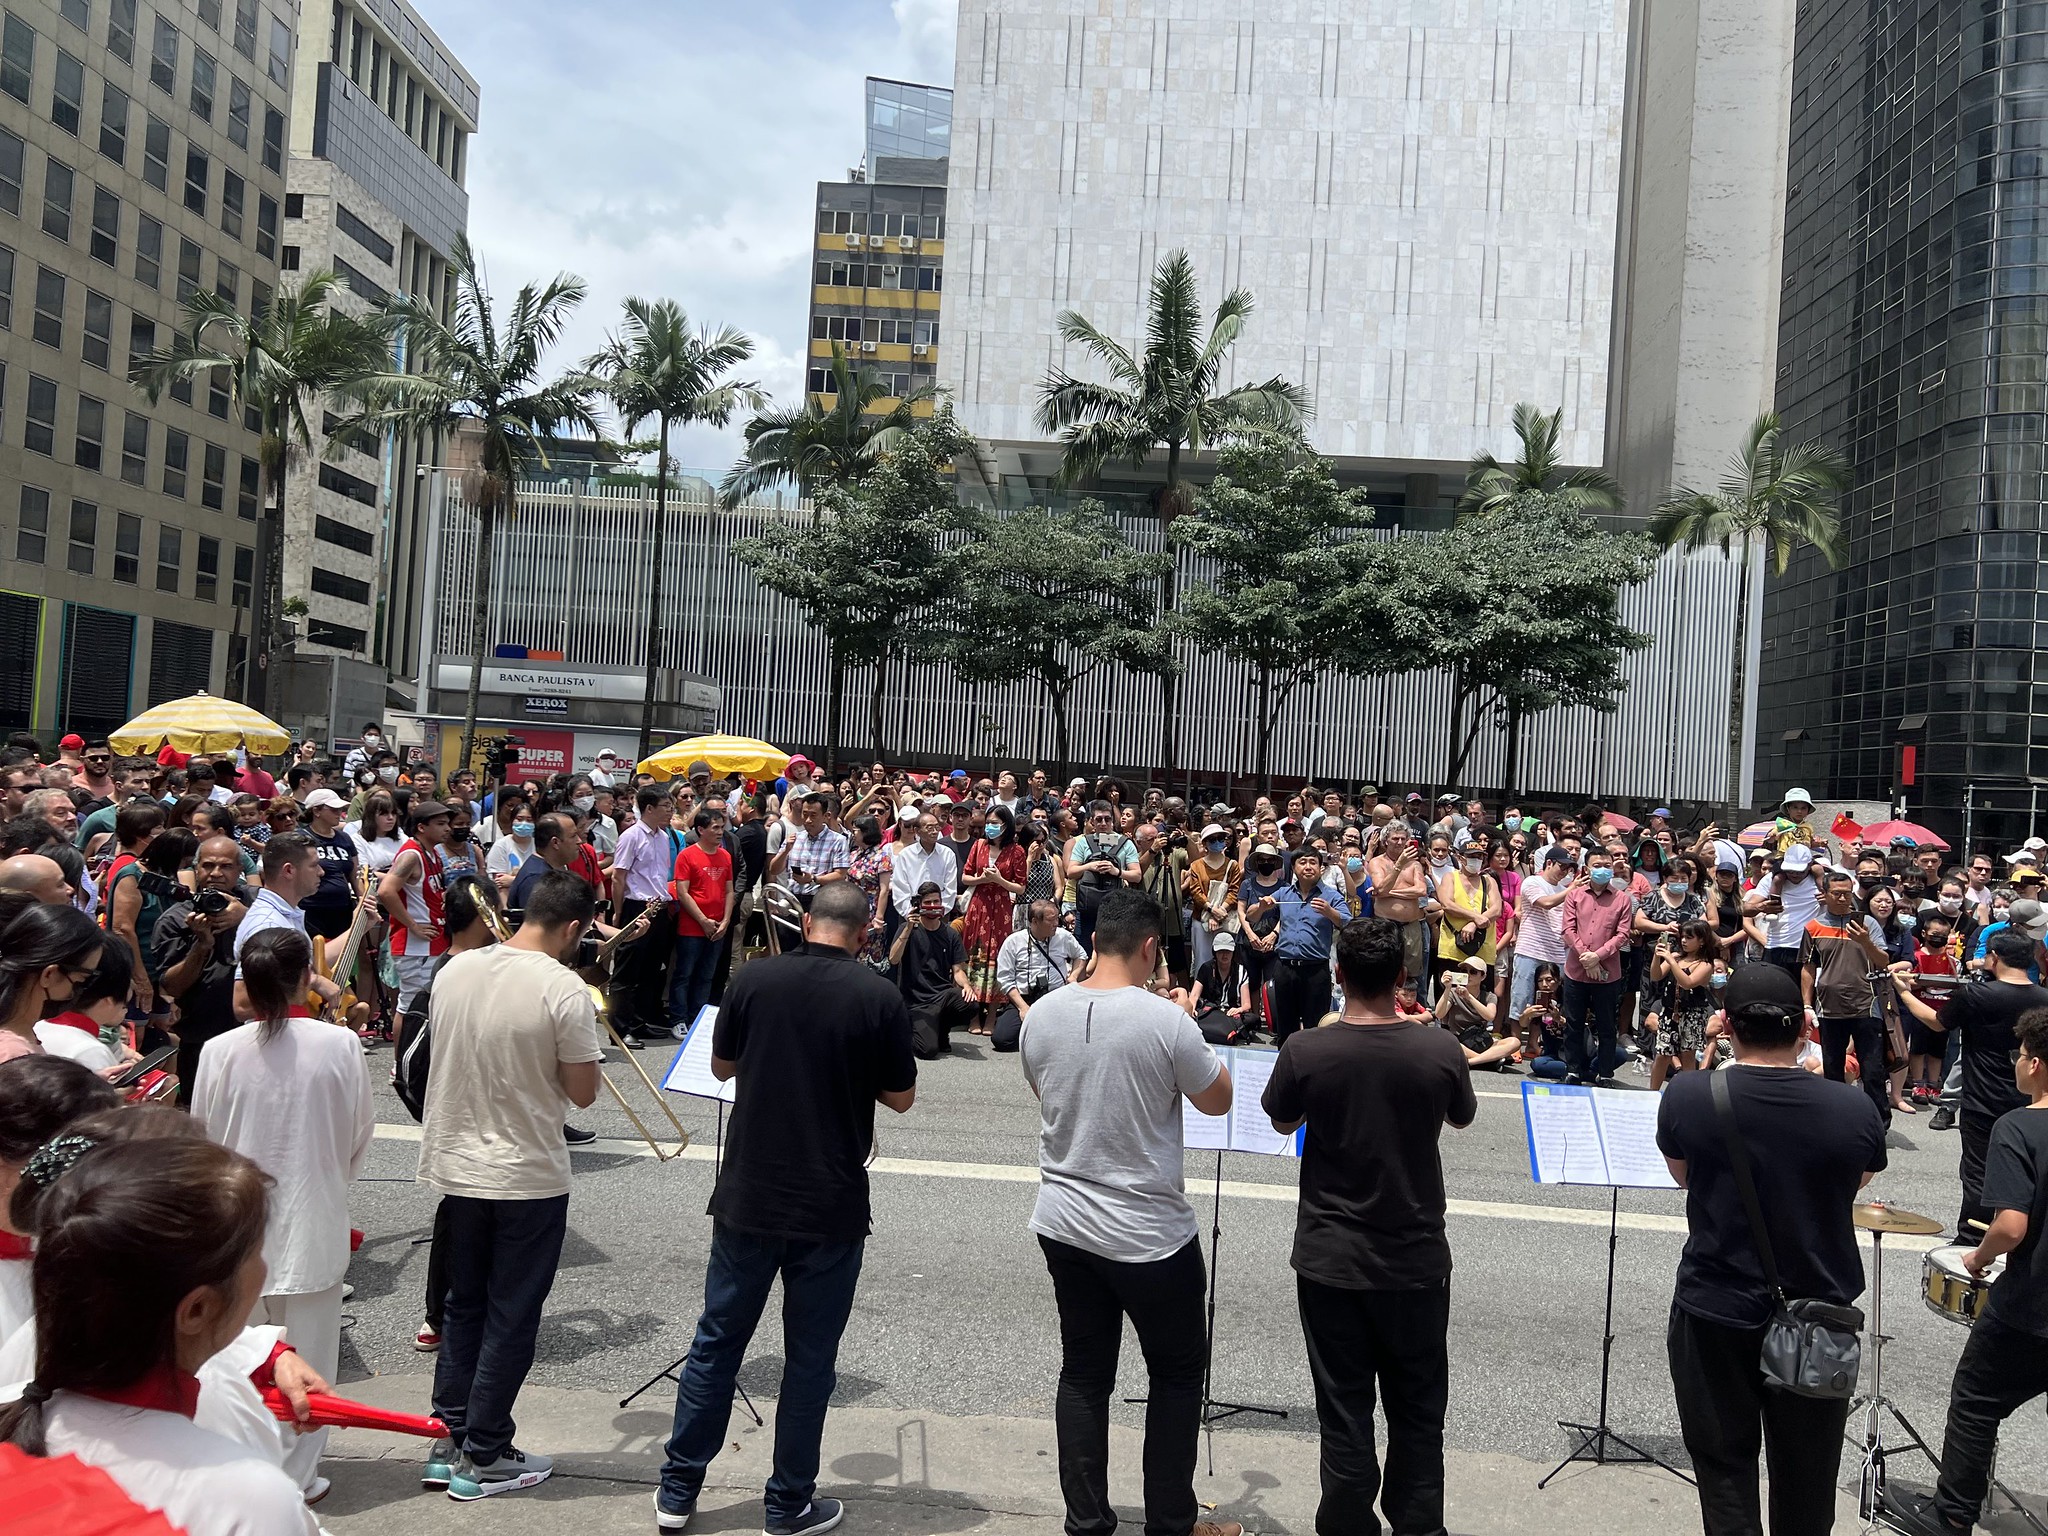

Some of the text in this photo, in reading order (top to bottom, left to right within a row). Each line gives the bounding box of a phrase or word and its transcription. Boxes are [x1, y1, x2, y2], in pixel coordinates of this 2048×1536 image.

[499, 673, 535, 683] BANCA
[537, 675, 585, 686] PAULISTA
[526, 697, 567, 708] XEROX
[517, 747, 564, 763] SUPER
[518, 760, 564, 768] NTERESSANTE
[579, 756, 634, 769] veja SDE
[316, 846, 349, 861] GAP
[520, 1475, 538, 1485] PUMA
